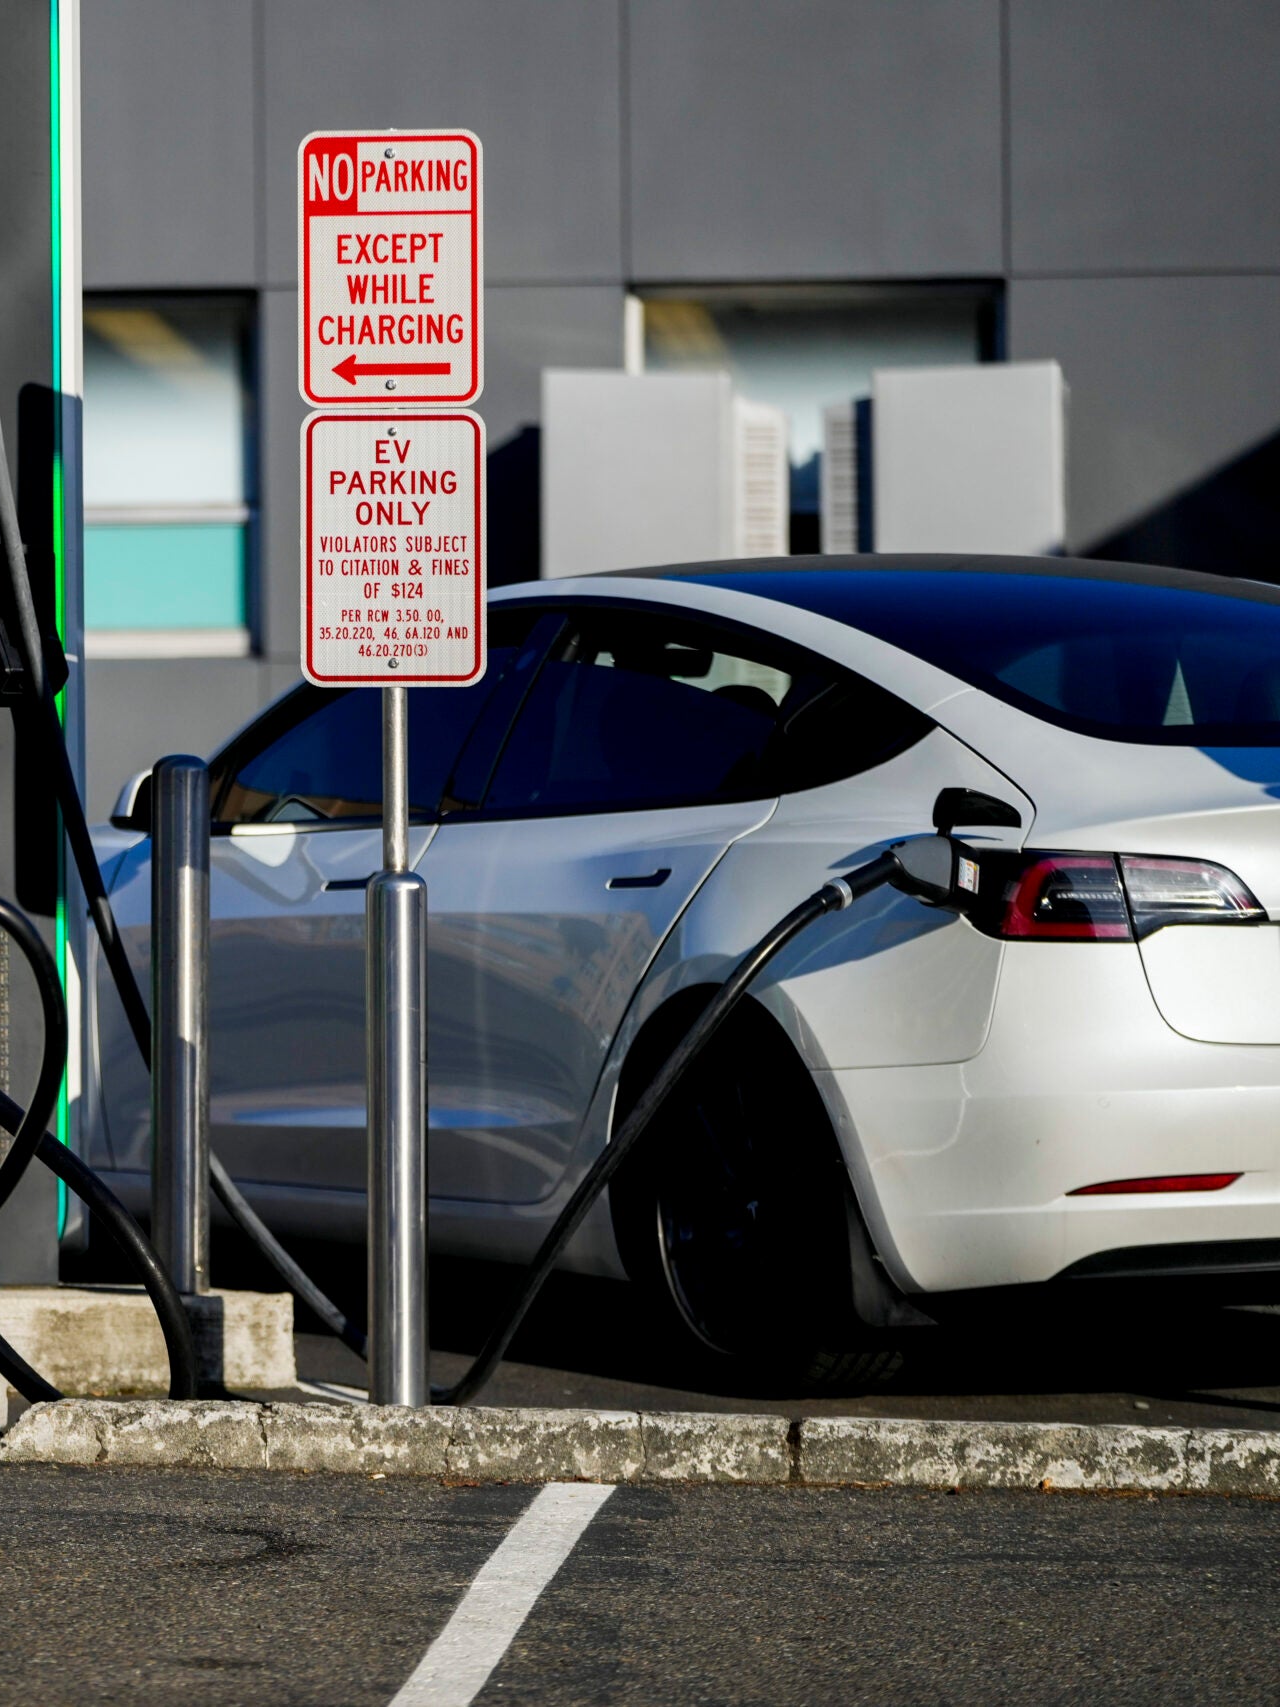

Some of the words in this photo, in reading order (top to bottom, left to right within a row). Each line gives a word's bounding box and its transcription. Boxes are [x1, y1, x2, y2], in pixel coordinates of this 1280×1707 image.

[309, 153, 355, 202] NO
[361, 159, 468, 193] PARKING
[336, 232, 444, 265] EXCEPT
[346, 273, 435, 305] WHILE
[318, 313, 464, 346] CHARGING
[375, 439, 411, 464] EV
[330, 470, 458, 495] PARKING
[356, 501, 431, 526] ONLY
[320, 536, 397, 553] VIOLATORS
[406, 536, 467, 553] SUBJECT
[318, 559, 334, 576] TO
[341, 559, 400, 576] CITATION
[408, 559, 423, 576] &
[432, 559, 469, 576] FINES
[364, 583, 381, 599] OF
[391, 582, 423, 599] $124
[341, 609, 361, 622] PER
[368, 609, 389, 622] RCW
[320, 627, 376, 641] 35.20.220,
[447, 627, 468, 639] AND
[358, 644, 428, 657] 46.20.270(3)
